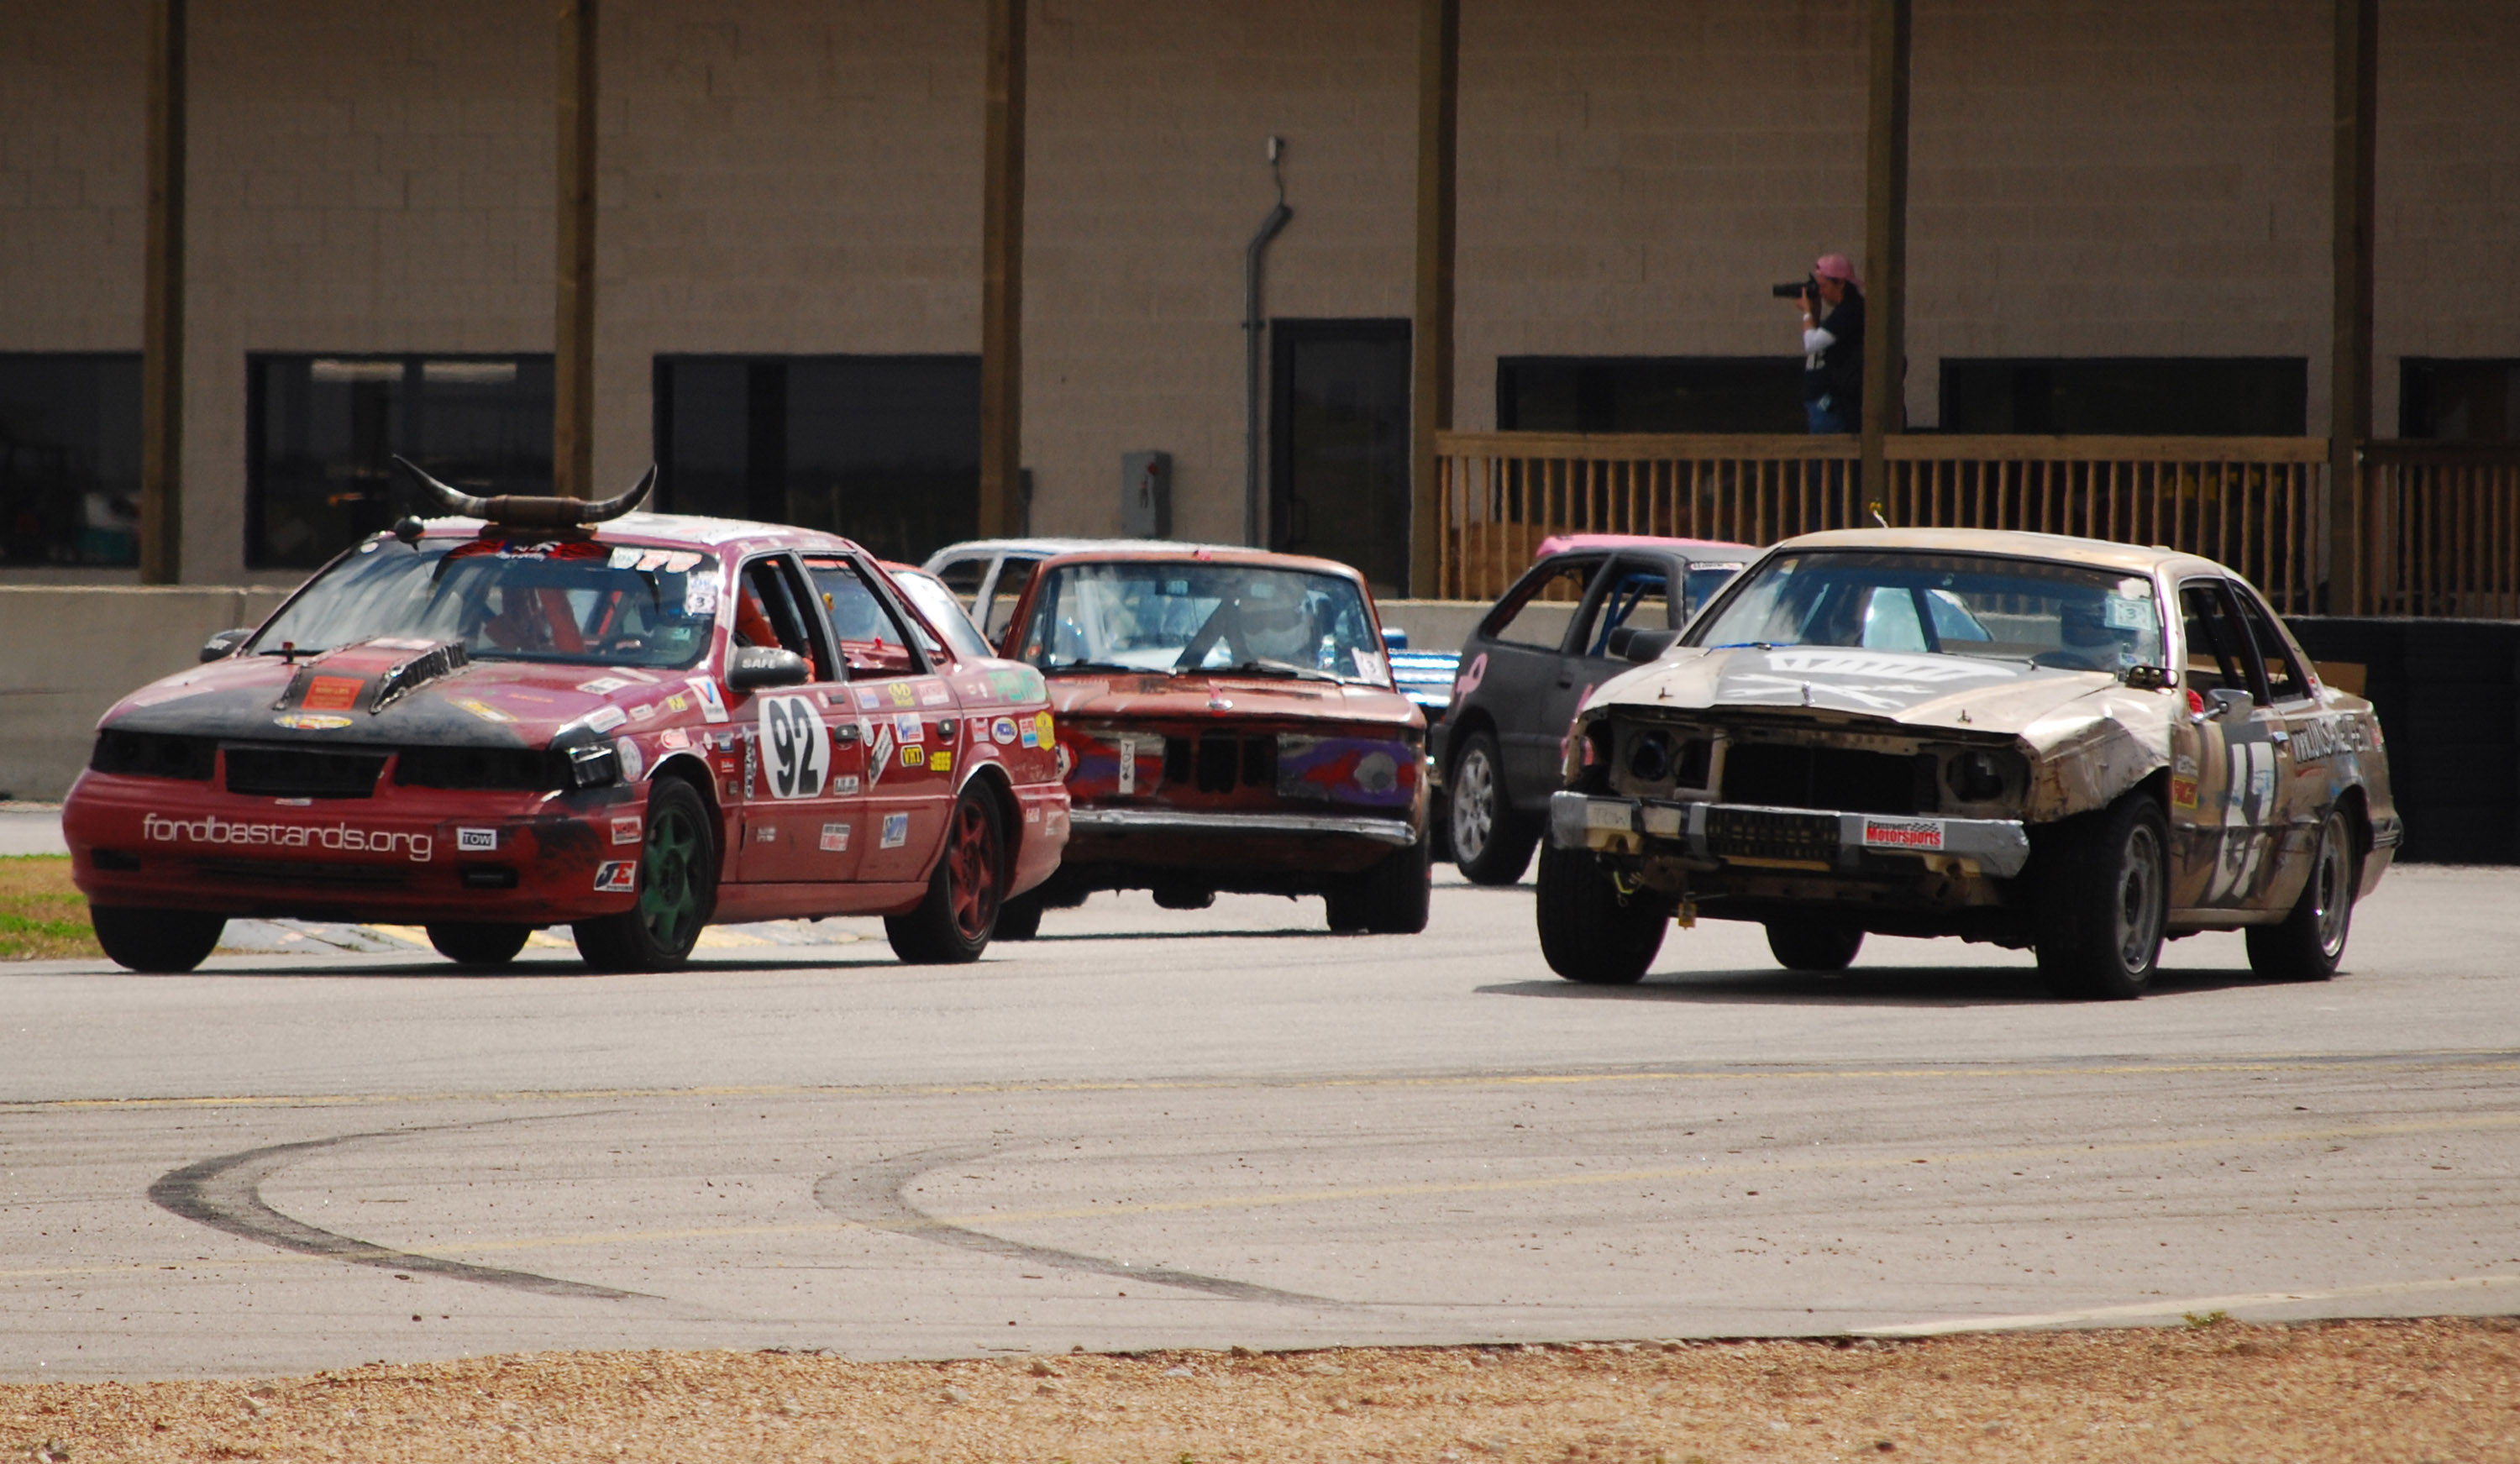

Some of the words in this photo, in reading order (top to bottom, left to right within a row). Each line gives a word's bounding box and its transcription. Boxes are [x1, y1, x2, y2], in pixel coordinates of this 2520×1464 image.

[696, 596, 705, 606] 3
[2125, 609, 2136, 620] 3
[742, 659, 777, 669] SAFE
[769, 698, 818, 797] 92
[143, 812, 433, 862] fordbastards.org
[463, 832, 492, 846] TOW
[1866, 826, 1941, 847] Motorsports
[596, 862, 635, 888] JE
